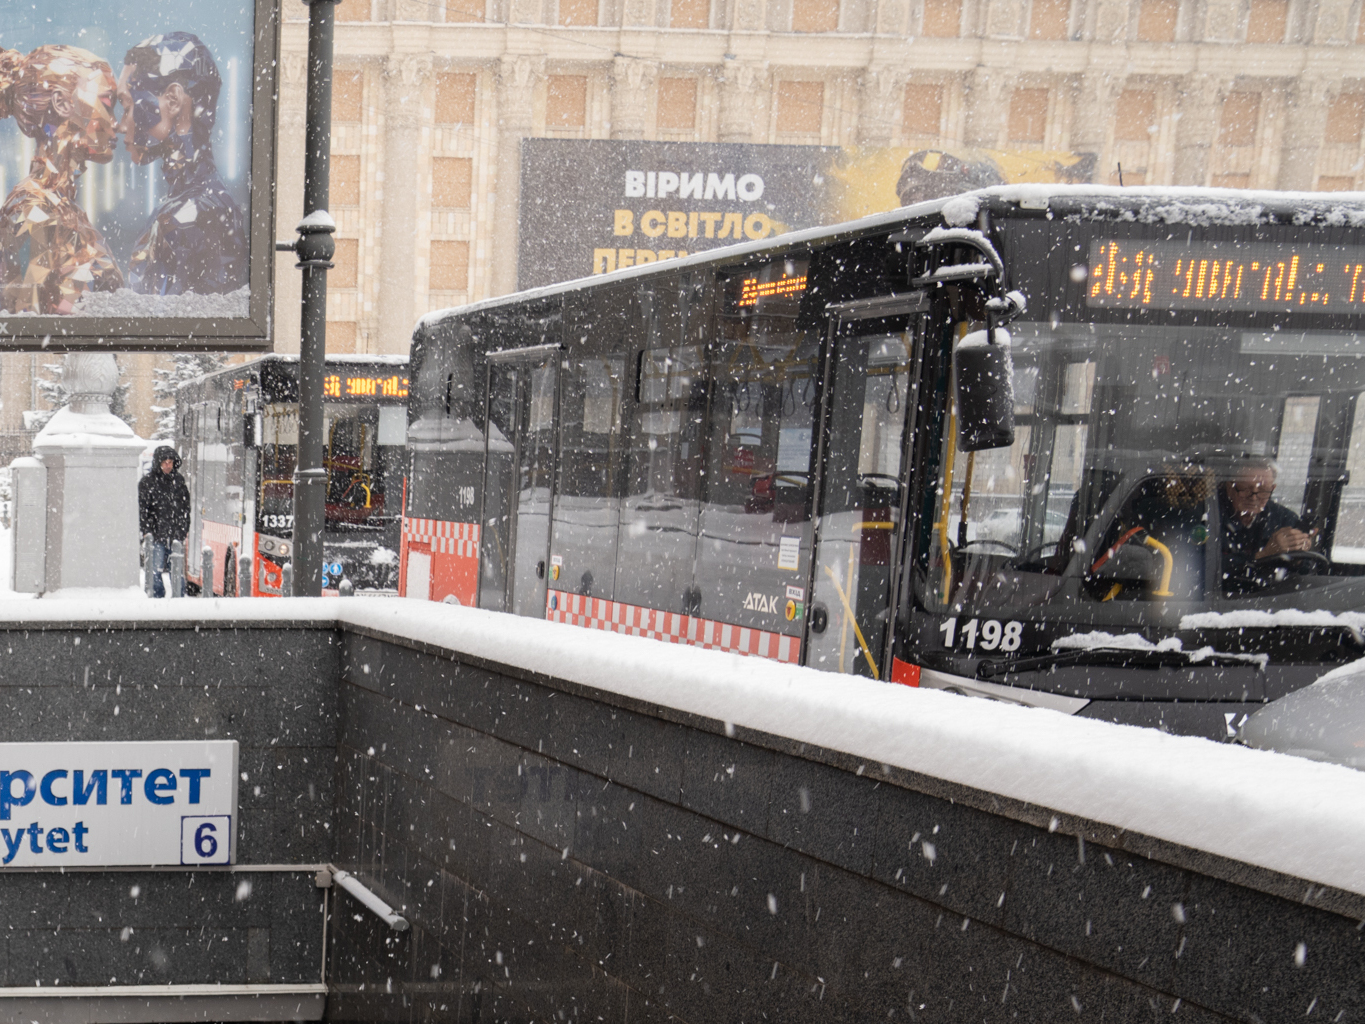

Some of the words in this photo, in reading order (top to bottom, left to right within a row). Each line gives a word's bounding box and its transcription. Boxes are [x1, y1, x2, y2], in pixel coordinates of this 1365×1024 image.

[625, 170, 765, 201] ВІРИМО
[614, 209, 634, 236] В
[640, 210, 771, 240] СВІТЛО
[262, 515, 294, 528] 1337
[742, 592, 779, 614] ATAK
[939, 617, 1023, 652] 1198
[193, 822, 218, 859] 6
